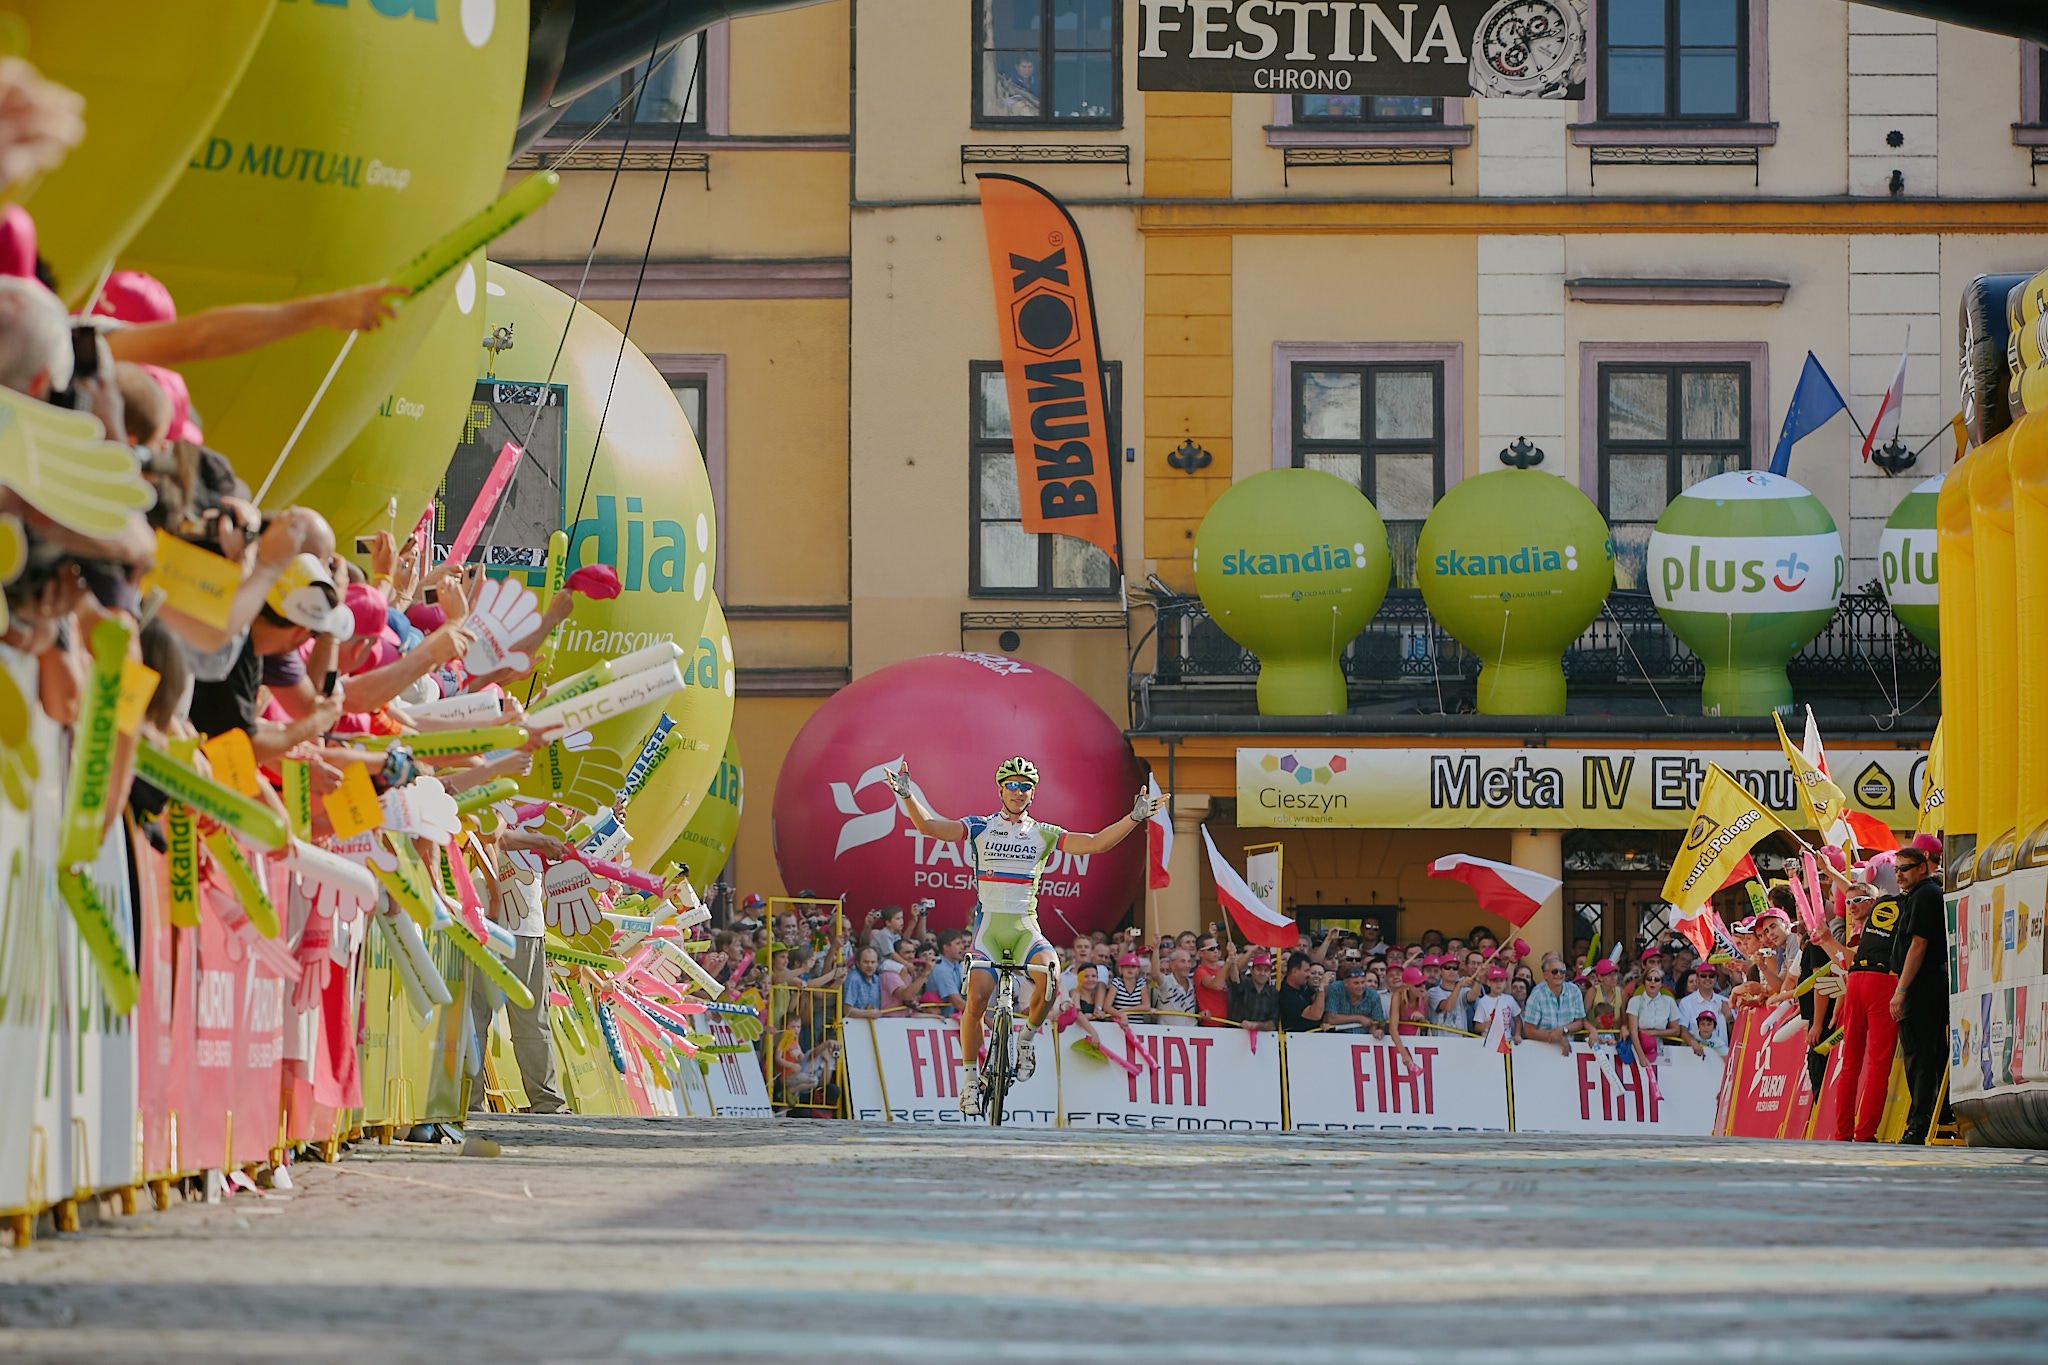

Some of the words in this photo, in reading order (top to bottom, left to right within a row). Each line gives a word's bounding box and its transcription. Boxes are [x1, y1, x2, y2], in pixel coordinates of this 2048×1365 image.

[1138, 0, 1468, 63] FESTINA
[1252, 68, 1353, 91] CHRONO
[238, 143, 363, 188] MUTUAL
[1222, 543, 1351, 576] skandia
[1435, 546, 1561, 576] skandia
[1663, 545, 1766, 602] plus
[1882, 538, 1939, 597] plu
[549, 738, 564, 790] kandia
[1430, 755, 1564, 810] Meta
[1582, 756, 1635, 810] IV
[1651, 757, 1798, 811] Etpu
[1259, 788, 1348, 820] Cieszyn
[1273, 813, 1291, 823] robi
[905, 828, 1091, 876] TAUON
[984, 851, 1036, 860] cannondale
[985, 841, 1037, 854] LIQUIGAS
[550, 877, 591, 897] DZIENNIK
[914, 871, 978, 890] POLSK
[1037, 879, 1081, 898] ERGIA
[1125, 1034, 1214, 1107] FIAT
[1351, 1044, 1439, 1115] FIAT
